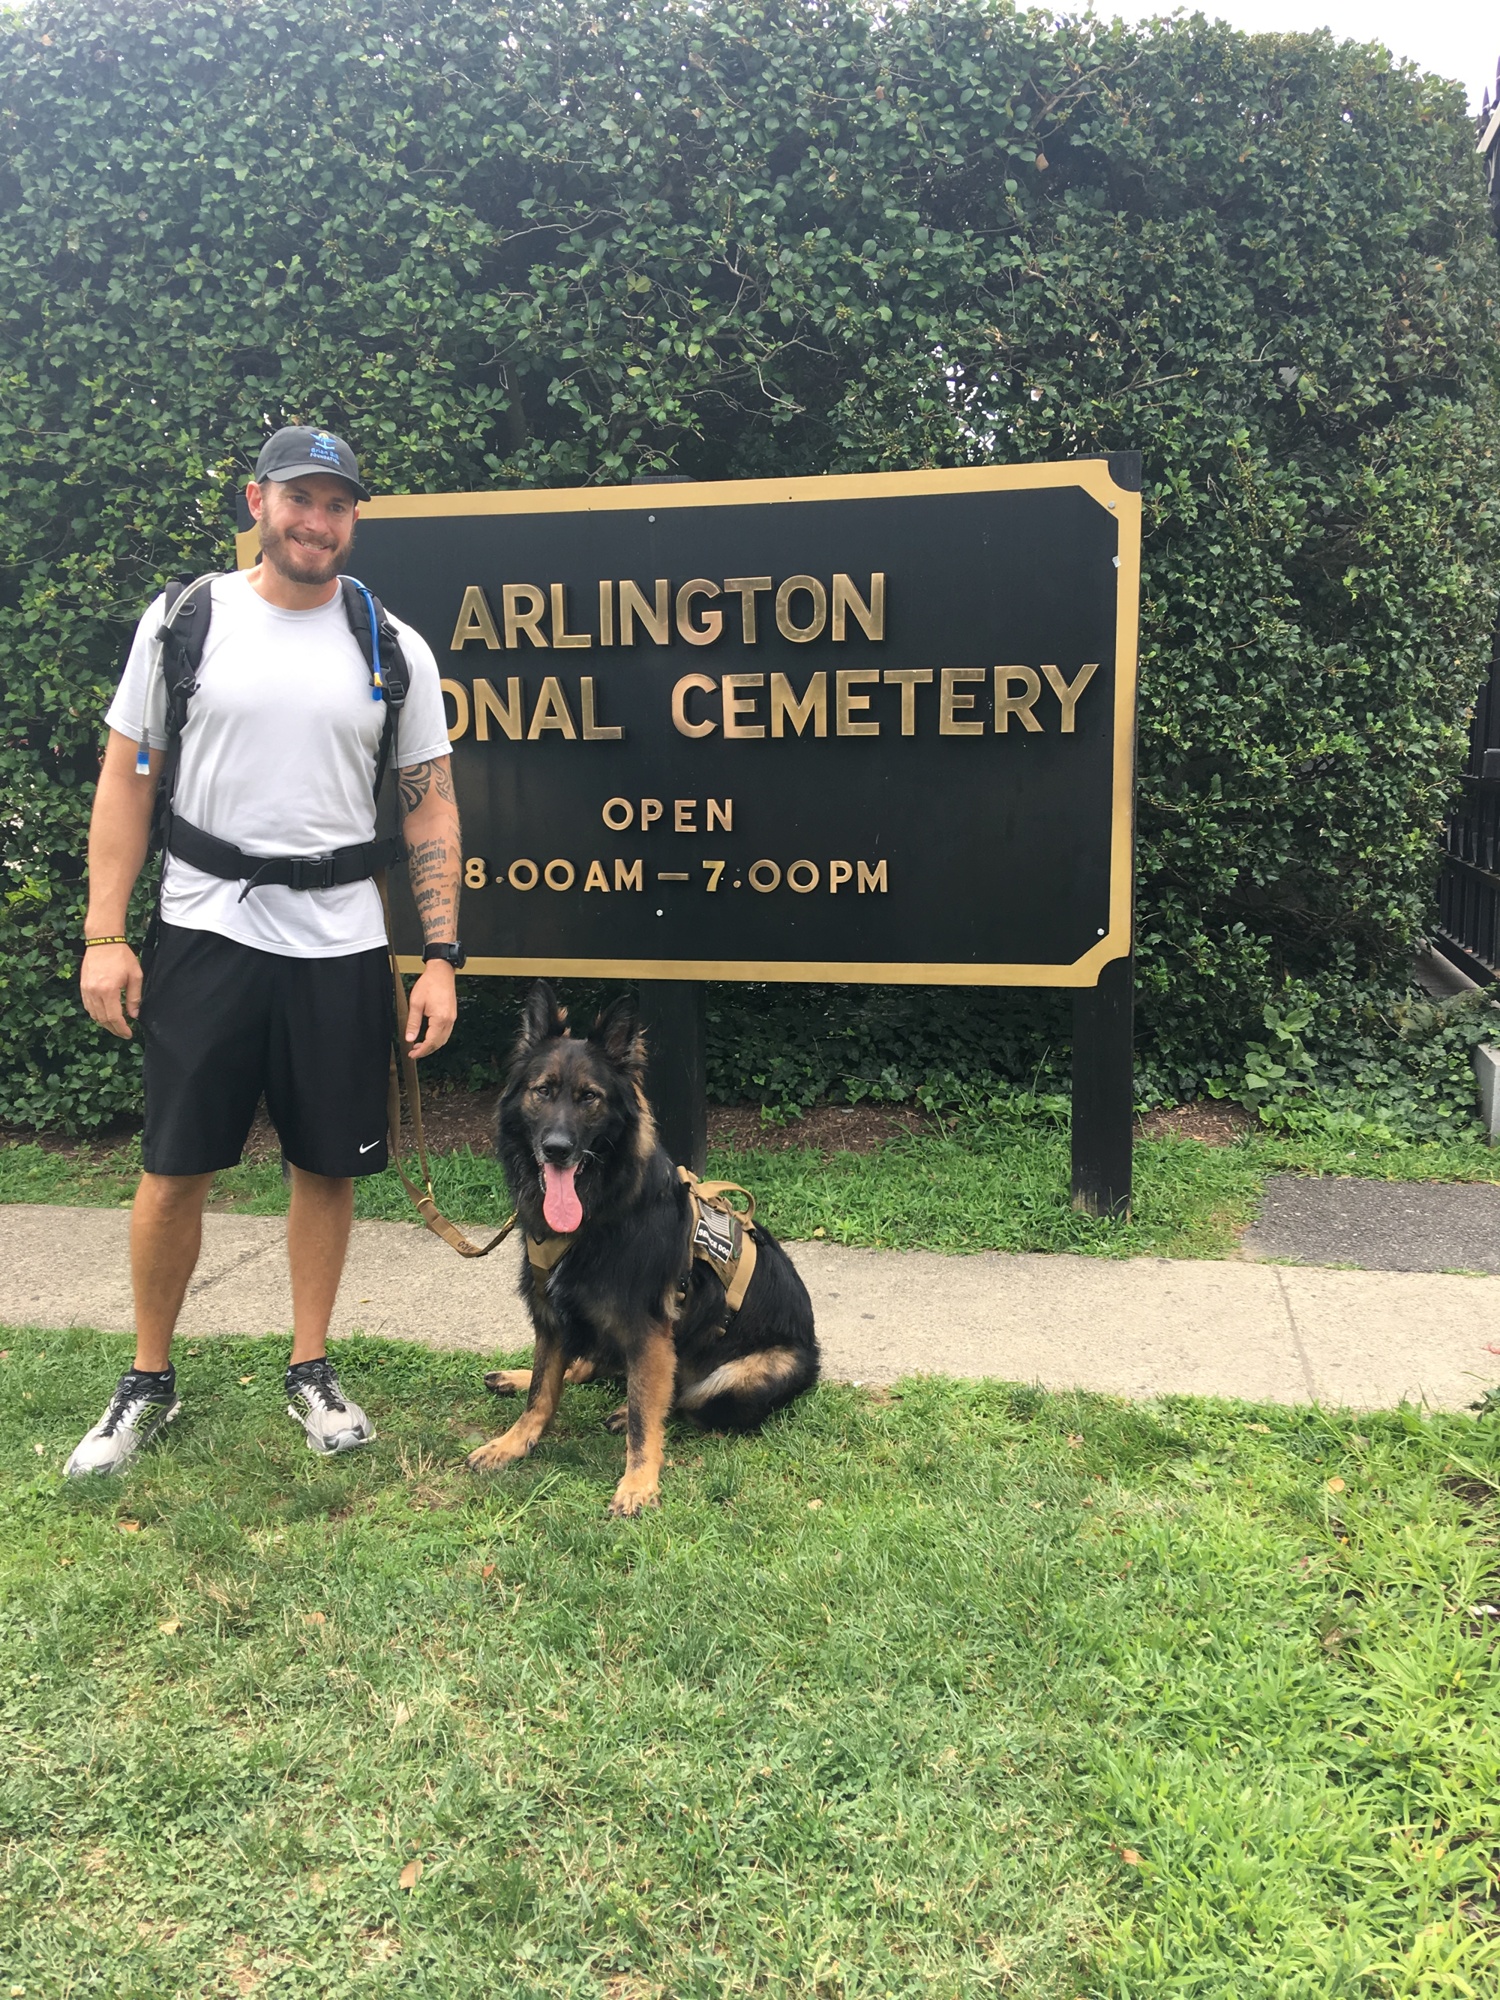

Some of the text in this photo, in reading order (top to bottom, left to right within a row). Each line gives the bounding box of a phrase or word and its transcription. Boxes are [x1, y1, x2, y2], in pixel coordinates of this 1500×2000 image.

[450, 572, 886, 651] ARLINGTON
[670, 663, 1099, 740] CEMETERY
[601, 796, 734, 833] OPEN
